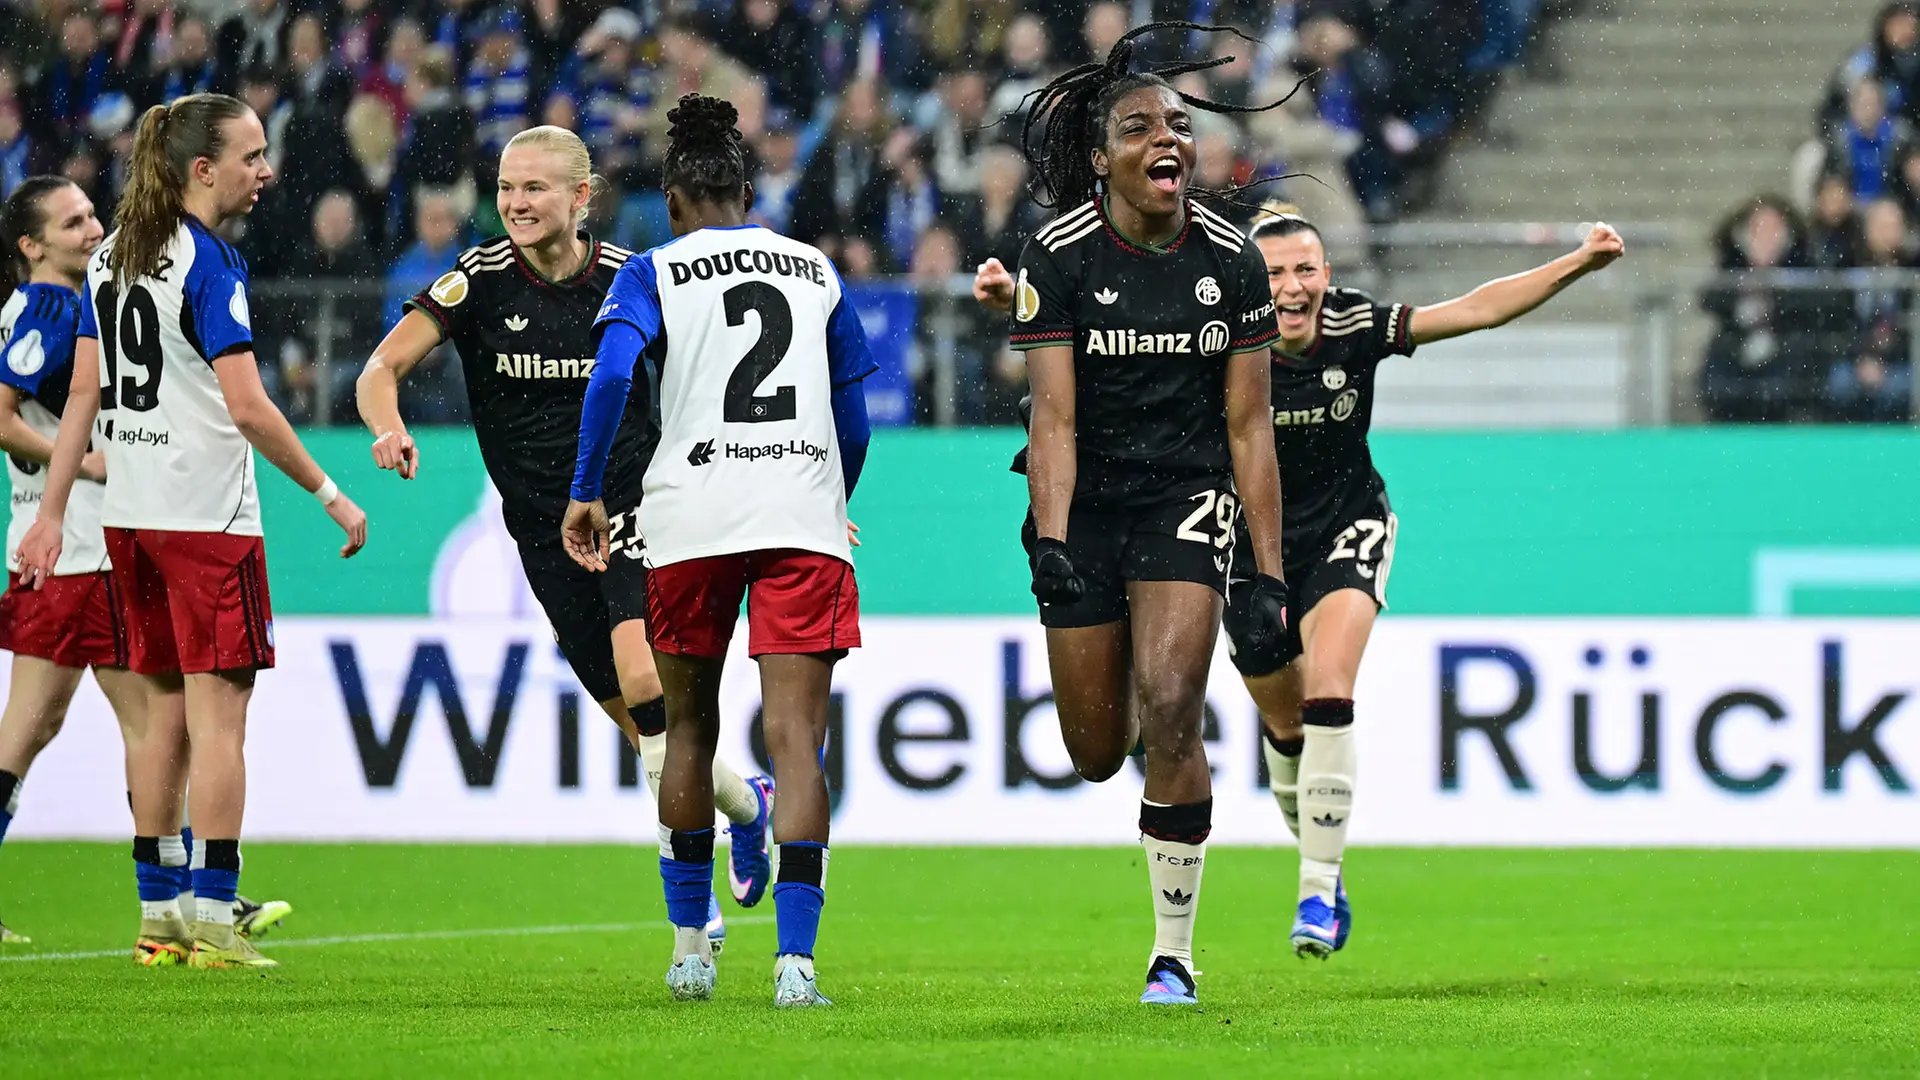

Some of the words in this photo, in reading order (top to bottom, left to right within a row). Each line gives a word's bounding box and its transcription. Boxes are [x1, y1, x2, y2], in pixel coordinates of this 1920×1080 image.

[668, 249, 826, 287] DOUCOURÉ
[95, 281, 164, 412] 19
[723, 281, 796, 423] 2
[1086, 328, 1192, 356] Allianz
[496, 353, 597, 379] Allianz
[725, 440, 828, 462] Hapag-Lloyd
[1176, 489, 1236, 549] 29
[1326, 519, 1385, 563] 27
[1438, 641, 1913, 792] Rück
